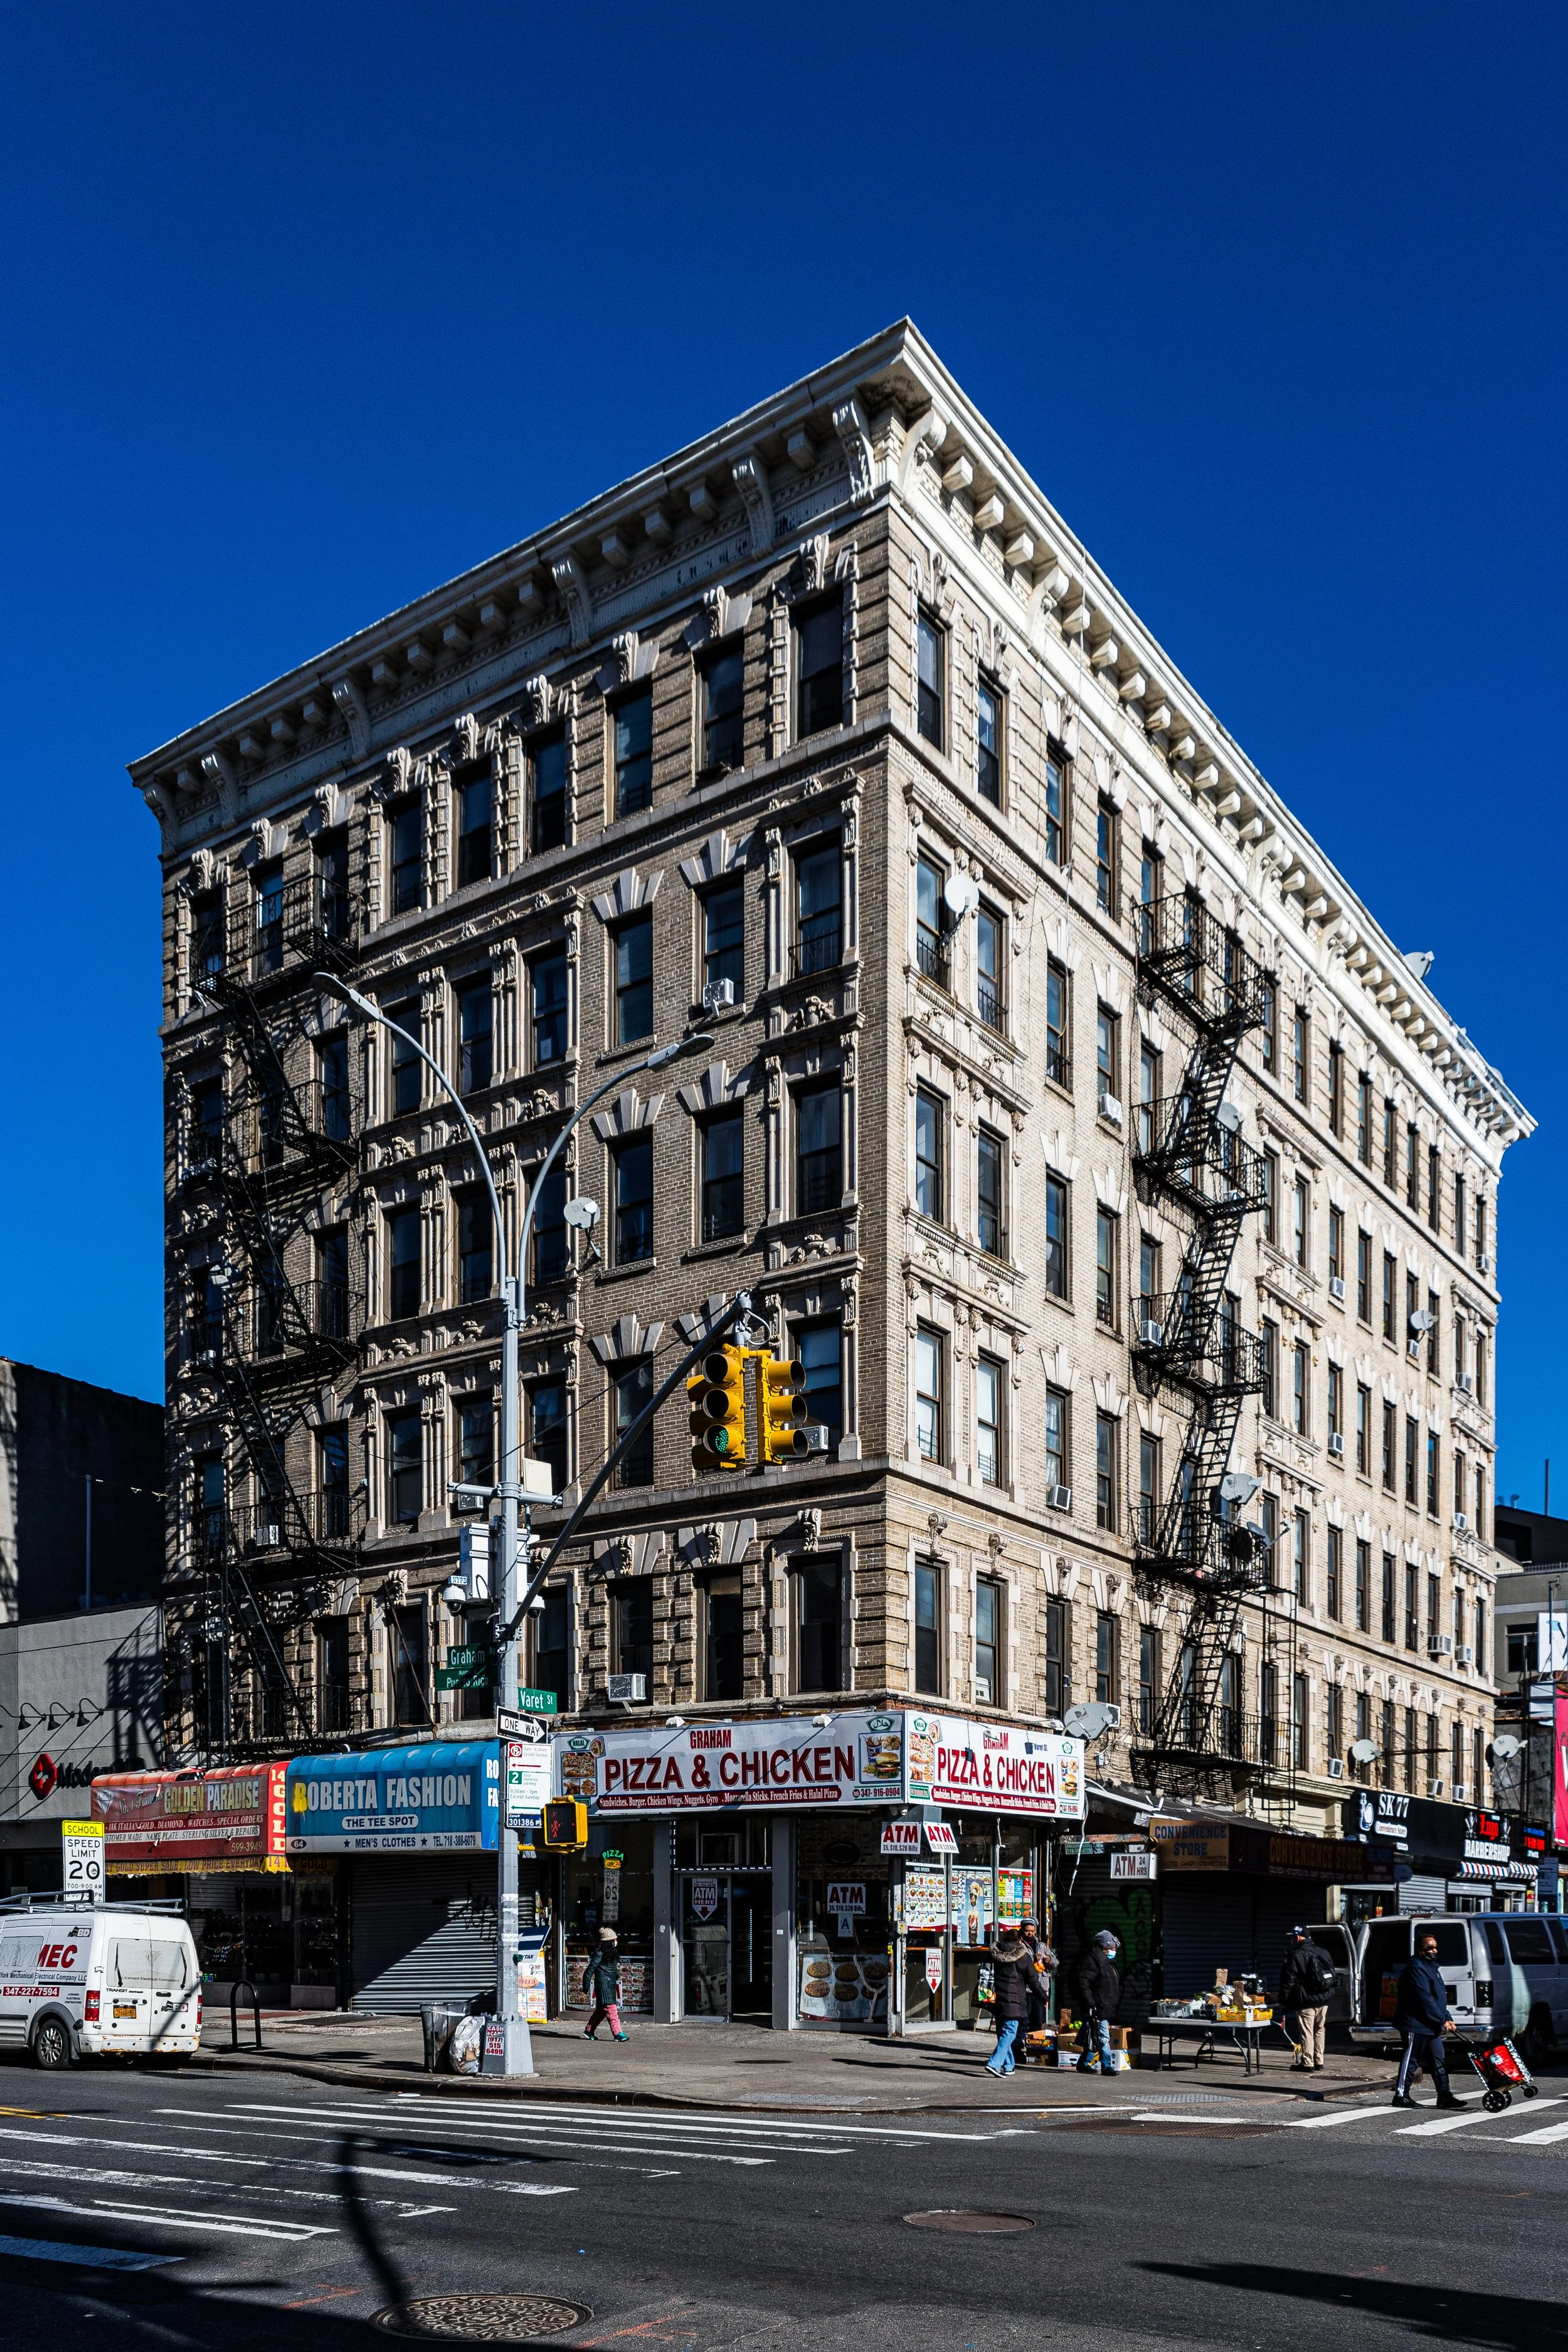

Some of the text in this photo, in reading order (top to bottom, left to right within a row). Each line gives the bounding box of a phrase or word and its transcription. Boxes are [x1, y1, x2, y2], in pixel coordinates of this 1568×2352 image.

[451, 1649, 485, 1665] Graham
[447, 1675, 489, 1688] Puerto Rico
[520, 1690, 553, 1709] Varet St
[504, 1718, 540, 1737] ONE WAY
[572, 1739, 585, 1747] HALAL
[690, 1729, 732, 1749] GRAHAM
[605, 1745, 855, 1791] PIZZA & CHICKEN
[938, 1747, 1055, 1795] PIZZA & CHICKEN
[271, 1769, 286, 1782] 14
[511, 1772, 519, 1784] 2
[164, 1785, 204, 1814] GOLDEN
[207, 1781, 259, 1811] PARADISE
[293, 1775, 470, 1813] ROBERTA FASHION
[647, 1796, 667, 1806] Chicken
[706, 1794, 718, 1806] Gyro
[724, 1792, 752, 1803] Mozzarella
[770, 1791, 788, 1801] French
[789, 1789, 803, 1799] Fries
[803, 1791, 808, 1799] &
[808, 1789, 823, 1799] Halal
[824, 1788, 838, 1799] Pizza
[109, 1814, 263, 1831] 18K ITALIAN SPECIAL ORDERS
[272, 1784, 286, 1851] GOLD
[346, 1816, 415, 1828] THE TEE SPOT
[509, 1818, 534, 1826] 301386
[67, 1825, 100, 1835] SCHOOL
[127, 1826, 259, 1841] MADE NAME STERLING SILVER & REPAIRS
[883, 1825, 918, 1843] ATM
[928, 1826, 954, 1843] ATM
[1155, 1826, 1227, 1839] CONVENIENCE
[67, 1839, 100, 1848] SPEED
[231, 1841, 263, 1853] 599-3949
[356, 1838, 378, 1848] MEN'S
[382, 1836, 416, 1848] CLOTHES
[433, 1836, 443, 1846] TEL.
[72, 1850, 97, 1858] LIMIT
[602, 1850, 625, 1861] PIZZA
[1173, 1842, 1207, 1856] STORE
[1269, 1836, 1334, 1868] CONVENIENCE
[1335, 1845, 1364, 1872] STORE
[1465, 1839, 1510, 1862] BARBERSHOP
[117, 1857, 261, 1872] GOLD SUPER LOW PRICE EVERYDAY
[268, 1857, 280, 1868] 14
[1114, 1856, 1145, 1876] ATM 24
[68, 1860, 100, 1880] 20
[1136, 1867, 1147, 1876] HRS
[694, 1887, 715, 1899] ATM
[829, 1887, 864, 1904] ATM
[841, 1918, 850, 1930] A
[77, 1929, 90, 1937] BD
[928, 1958, 940, 1971] ATM
[56, 1973, 77, 1982] Company
[5, 1987, 58, 1996] 347-227-7594
